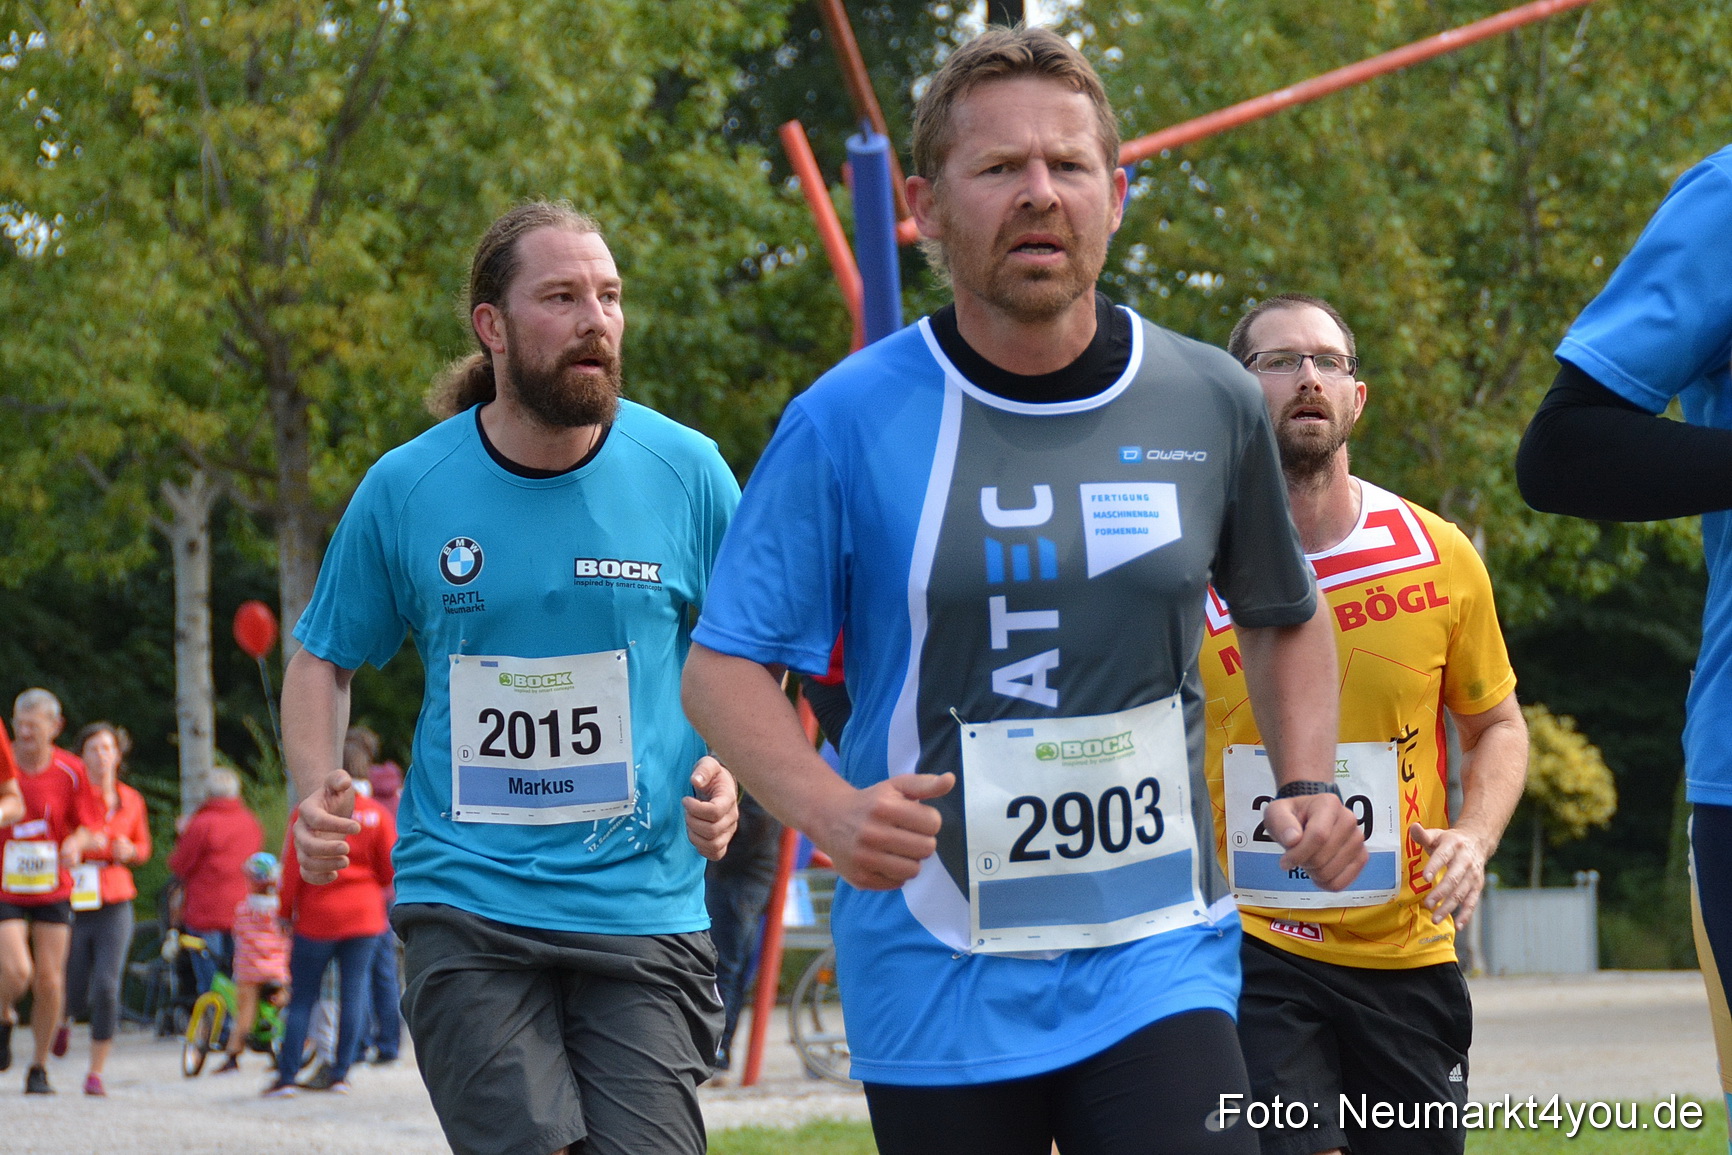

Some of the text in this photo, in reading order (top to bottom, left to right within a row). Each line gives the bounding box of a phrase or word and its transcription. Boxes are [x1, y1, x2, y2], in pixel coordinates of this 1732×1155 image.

[1091, 493, 1150, 503] FERTIGUNG
[1093, 510, 1160, 519] MASCHINENBAU
[1095, 526, 1149, 536] FORMENBAU
[443, 538, 480, 556] BMW
[574, 557, 662, 584] BOCK
[574, 579, 604, 588] inspired
[605, 580, 614, 588] by
[637, 583, 663, 592] concepts
[442, 590, 485, 606] PARTL
[980, 484, 1060, 708] ATEC
[445, 603, 486, 615] Neumarkt
[1333, 581, 1449, 632] BÖGL
[514, 671, 573, 688] BOCK
[478, 705, 602, 760] 2015
[462, 749, 469, 758] D
[1061, 731, 1134, 759] BOCK
[508, 777, 574, 795] Markus
[1006, 776, 1165, 863] 2903
[1252, 795, 1374, 843] 29
[1236, 835, 1243, 844] D
[984, 857, 993, 870] D
